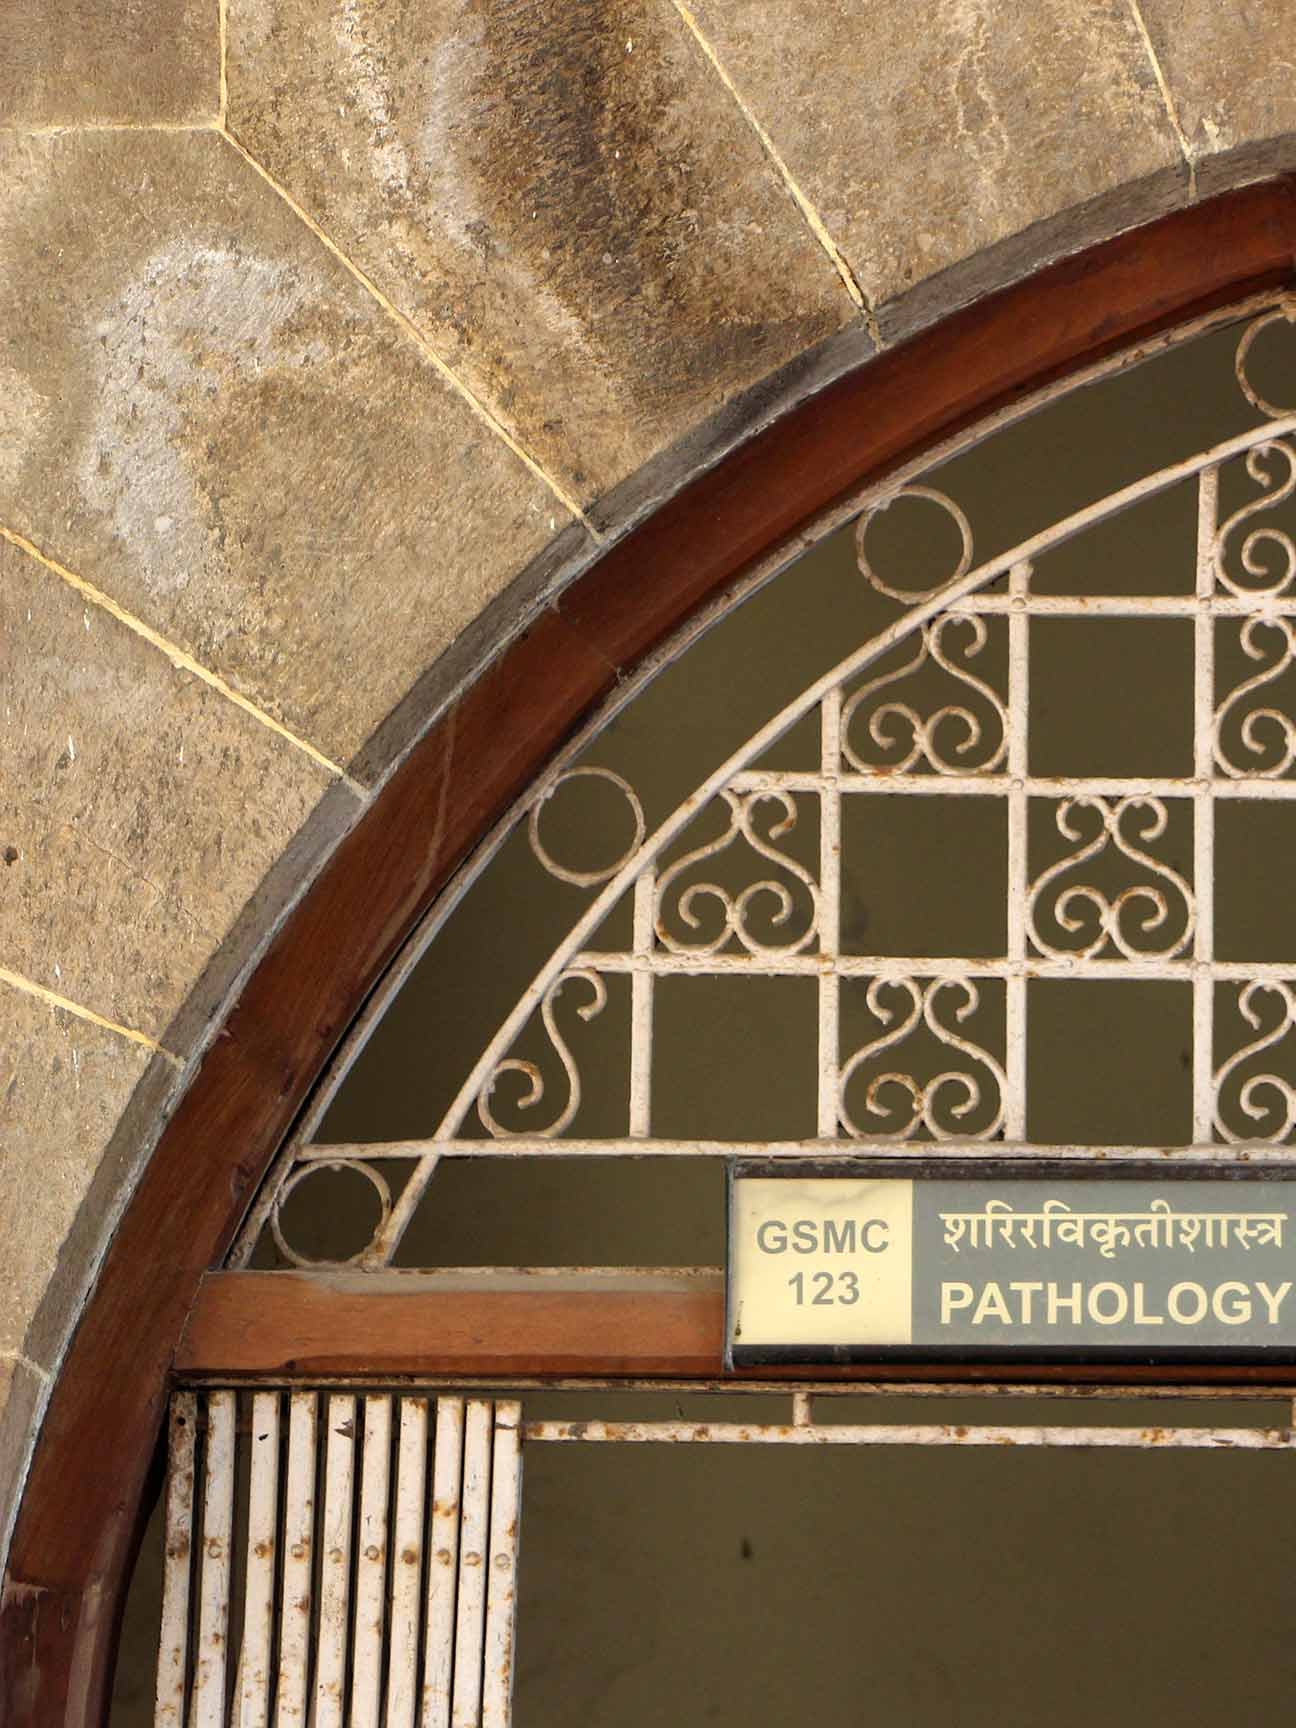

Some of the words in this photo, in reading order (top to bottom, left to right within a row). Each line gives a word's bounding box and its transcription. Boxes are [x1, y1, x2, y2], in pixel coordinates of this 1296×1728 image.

[756, 1219, 889, 1254] GSMC
[939, 1199, 1288, 1258] शरिरविकृतीशास्त्र
[787, 1271, 861, 1305] 123
[940, 1281, 1293, 1325] PATHOLOGY
